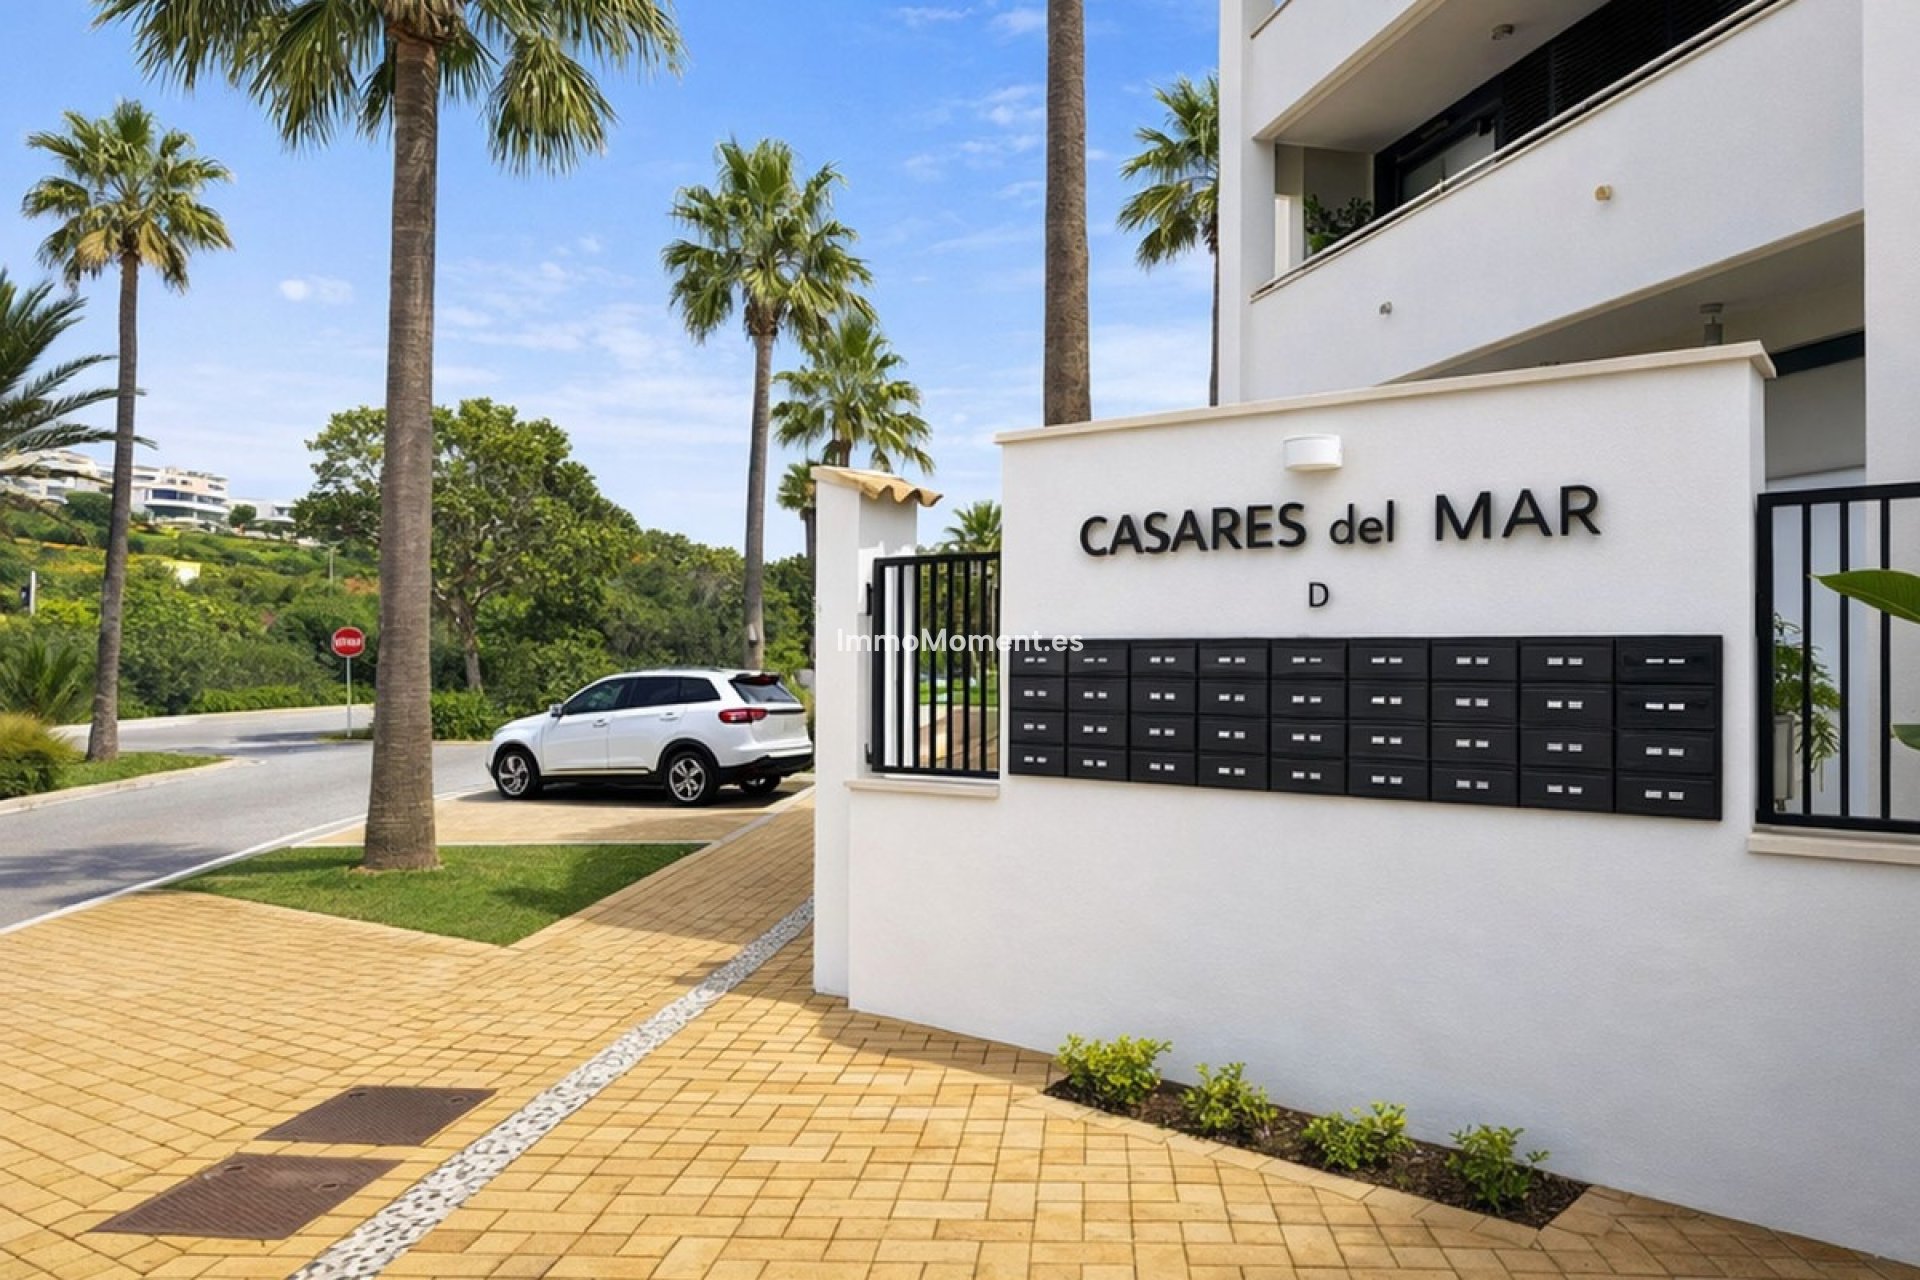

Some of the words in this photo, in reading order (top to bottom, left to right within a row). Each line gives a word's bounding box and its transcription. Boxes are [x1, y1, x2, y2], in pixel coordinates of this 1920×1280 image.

[1079, 501, 1308, 557] CASARES
[1329, 500, 1395, 545] del
[1434, 484, 1602, 541] MAR
[1308, 582, 1330, 608] D
